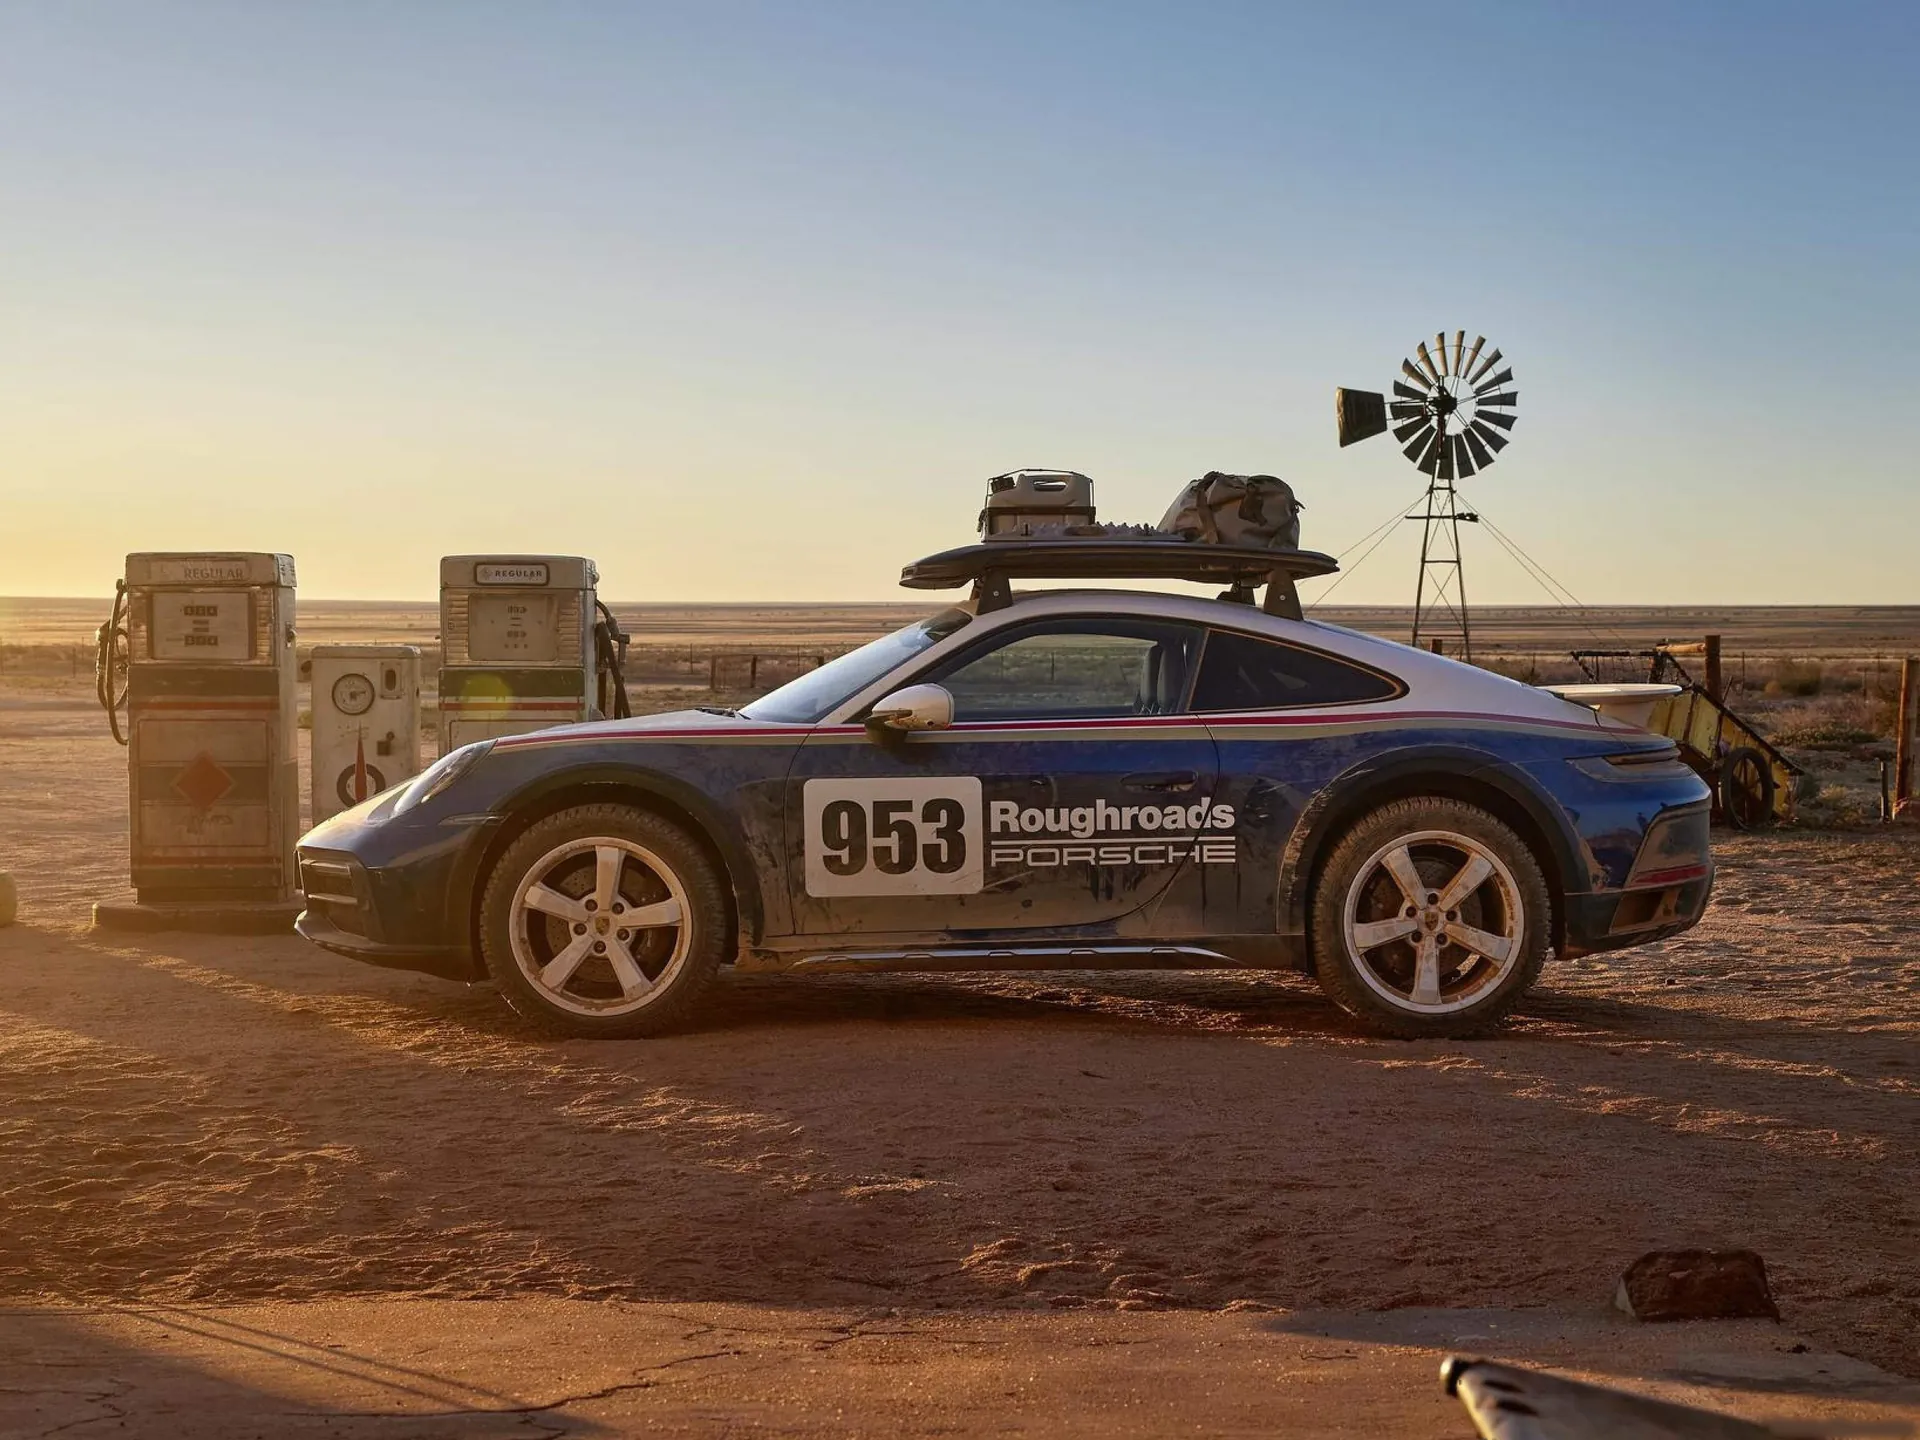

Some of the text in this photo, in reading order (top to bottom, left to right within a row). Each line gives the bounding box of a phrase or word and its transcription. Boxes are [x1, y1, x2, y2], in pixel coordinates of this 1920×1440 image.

[184, 568, 244, 580] REGULAR
[494, 569, 543, 578] REGULAR
[990, 797, 1236, 838] Roughroads
[821, 798, 966, 876] 953
[990, 844, 1236, 867] PORSCHE
